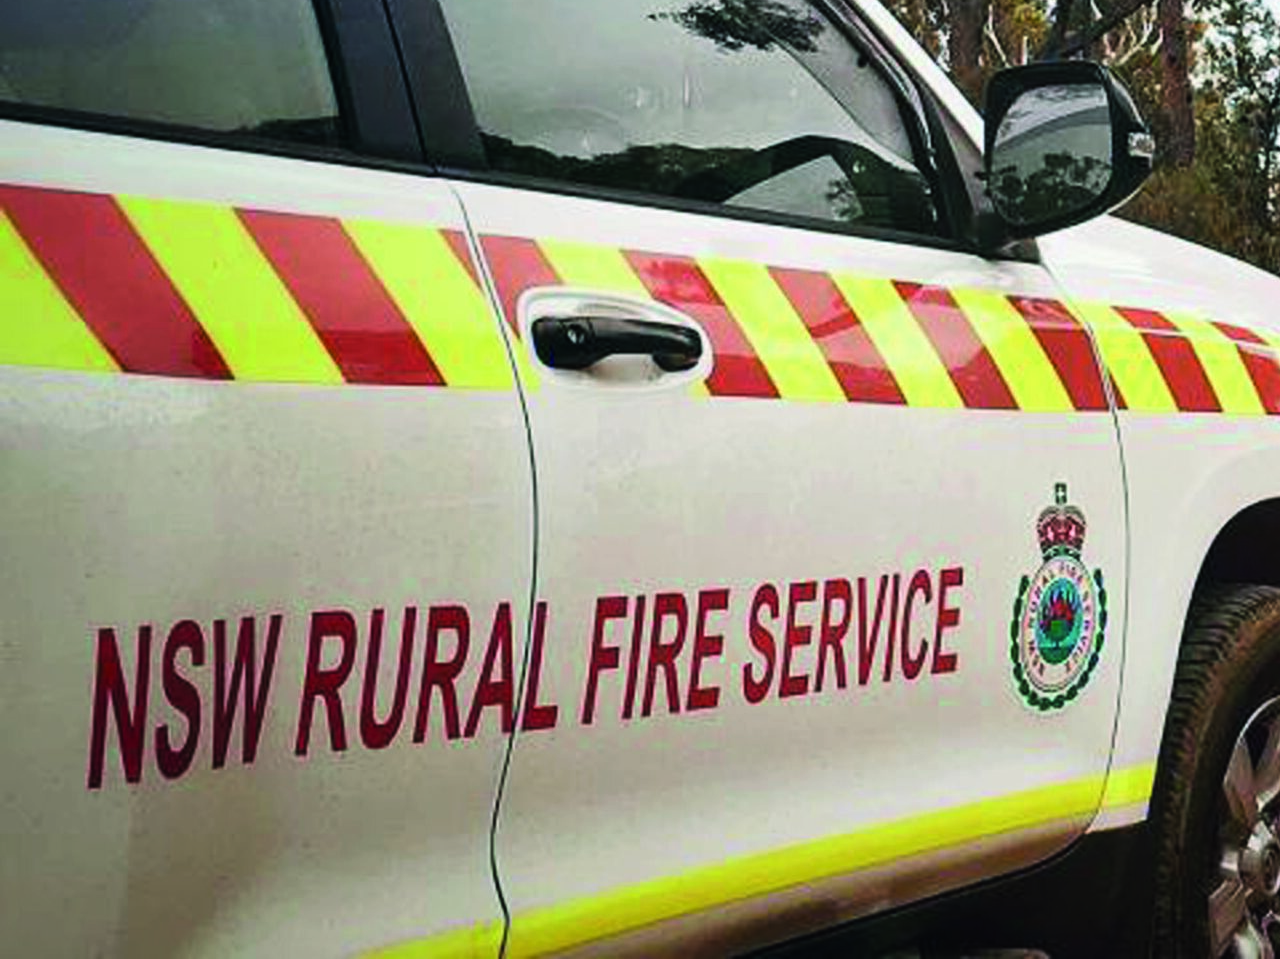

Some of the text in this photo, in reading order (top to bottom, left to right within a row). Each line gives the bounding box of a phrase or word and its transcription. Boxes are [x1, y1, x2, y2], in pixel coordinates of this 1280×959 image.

[86, 566, 964, 790] NSW RURAL FIRE SERVICE
